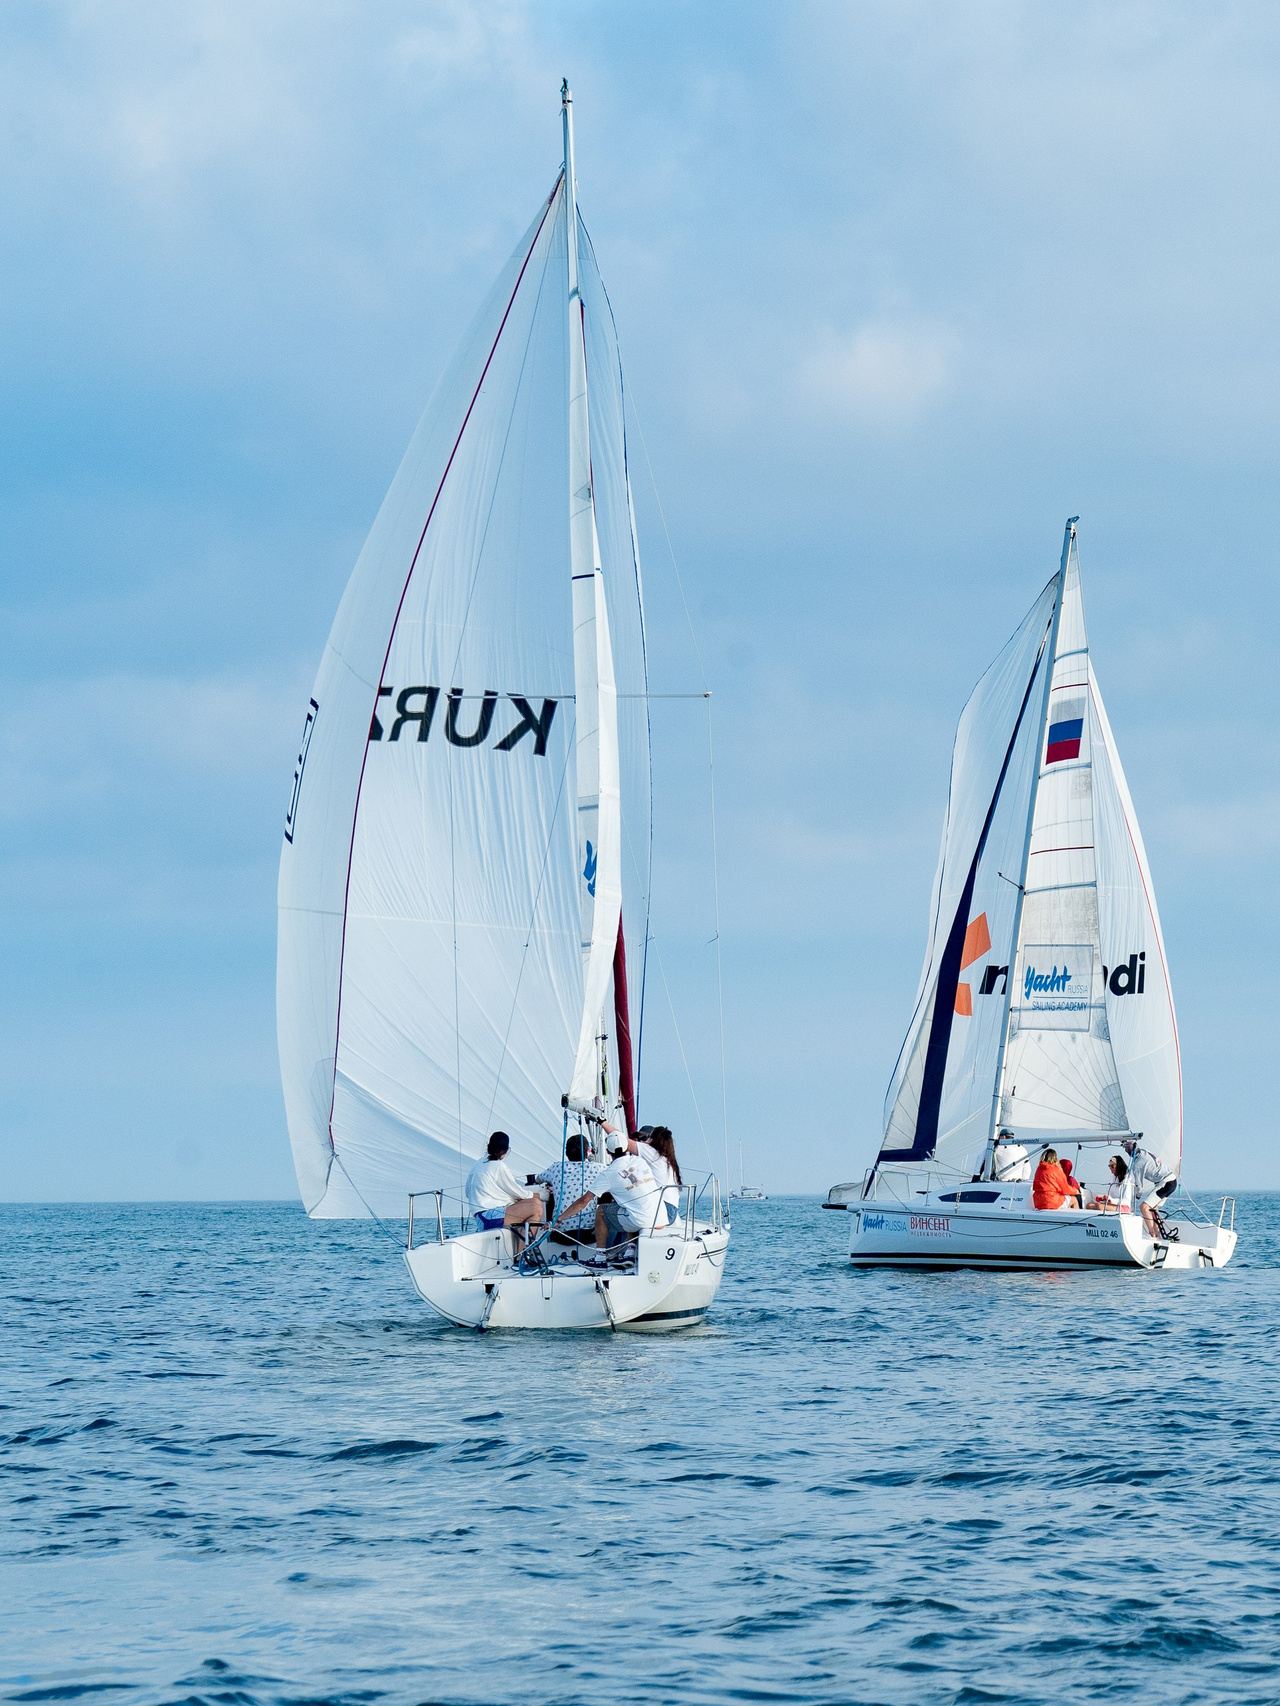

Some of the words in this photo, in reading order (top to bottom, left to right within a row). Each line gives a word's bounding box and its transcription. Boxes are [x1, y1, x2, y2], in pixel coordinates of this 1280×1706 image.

[1067, 984, 1089, 994] RUSSIA
[1032, 1001, 1055, 1011] SAILING
[1057, 1001, 1088, 1011] ACADEMY
[885, 1219, 907, 1232] RUSSIA
[910, 1216, 950, 1231] ВИНСЕНТ
[910, 1230, 952, 1238] НЕДВИЖИМОСТЬ
[1100, 1229, 1109, 1238] 02
[1110, 1230, 1119, 1239] 46
[665, 1247, 676, 1261] 9
